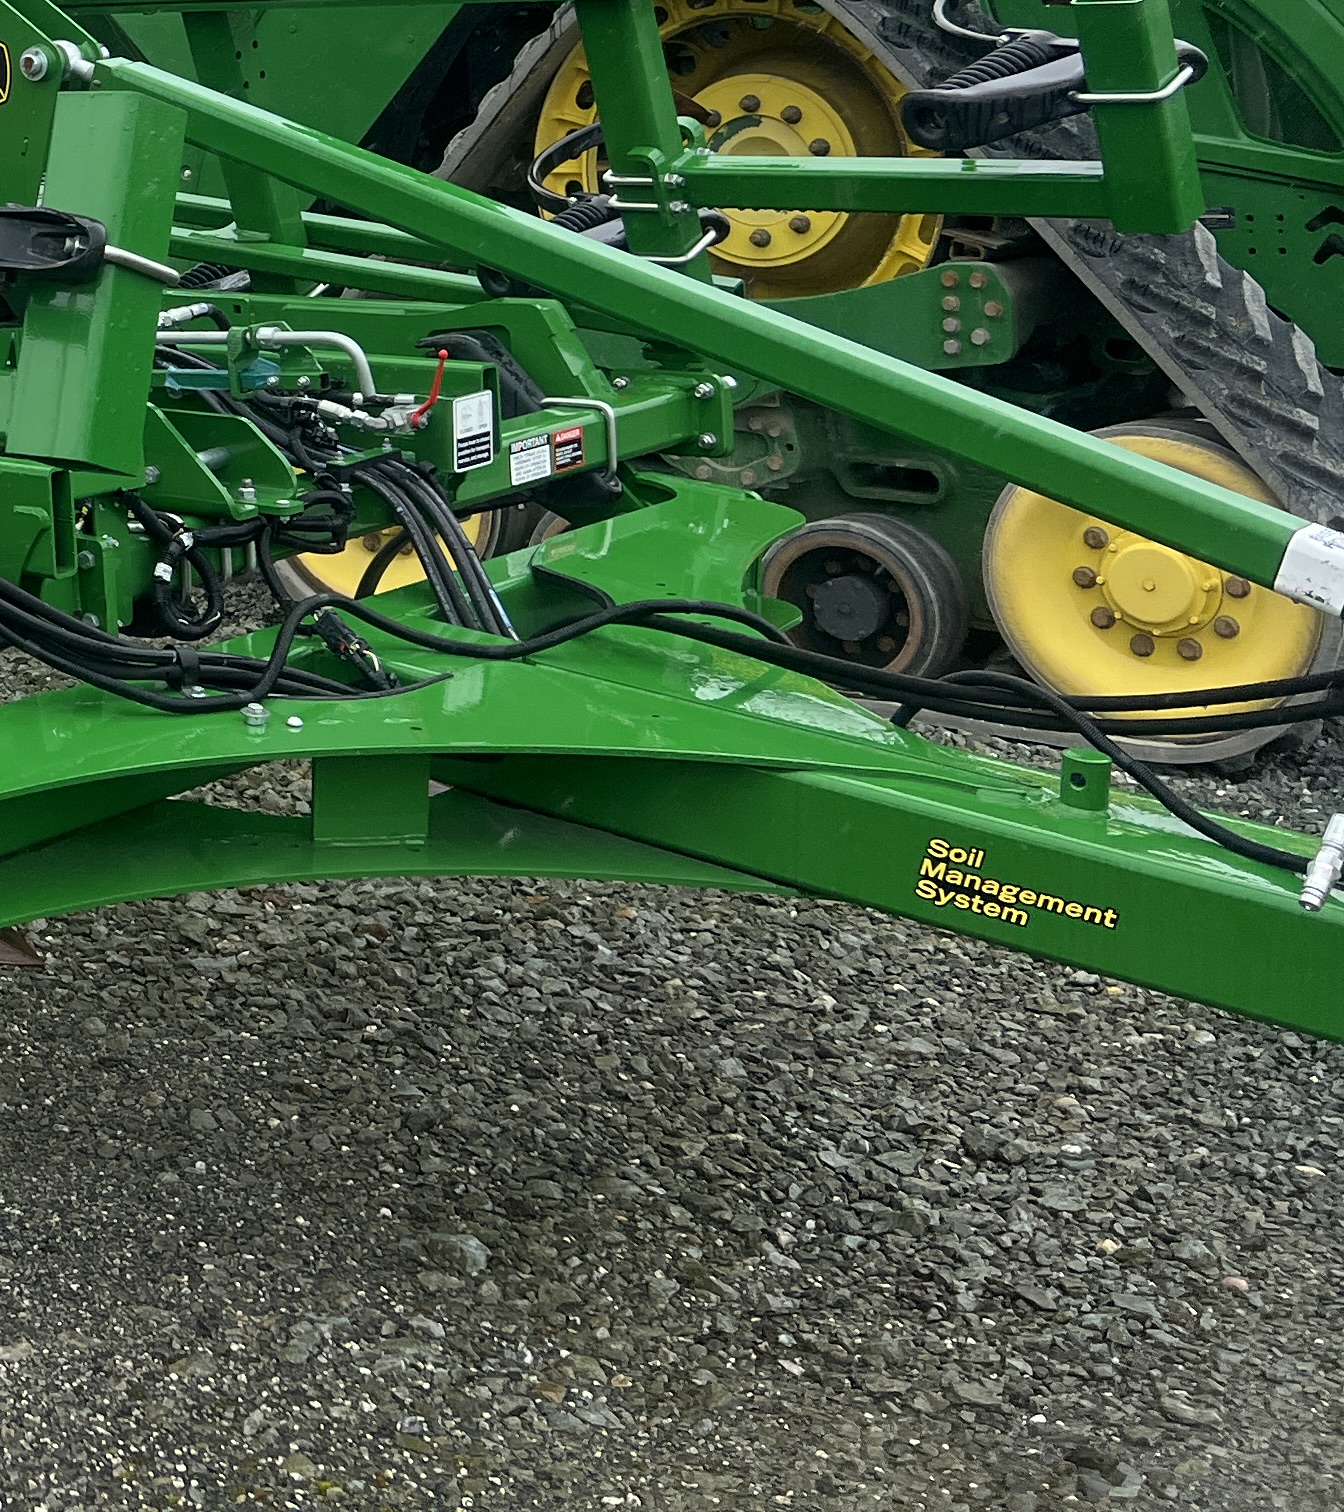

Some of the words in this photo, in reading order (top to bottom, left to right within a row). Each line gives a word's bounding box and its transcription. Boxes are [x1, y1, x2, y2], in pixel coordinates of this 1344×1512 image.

[511, 434, 549, 453] IMPORTANT
[926, 838, 985, 870] Soil
[914, 878, 1030, 927] System
[919, 857, 1119, 929] Management
